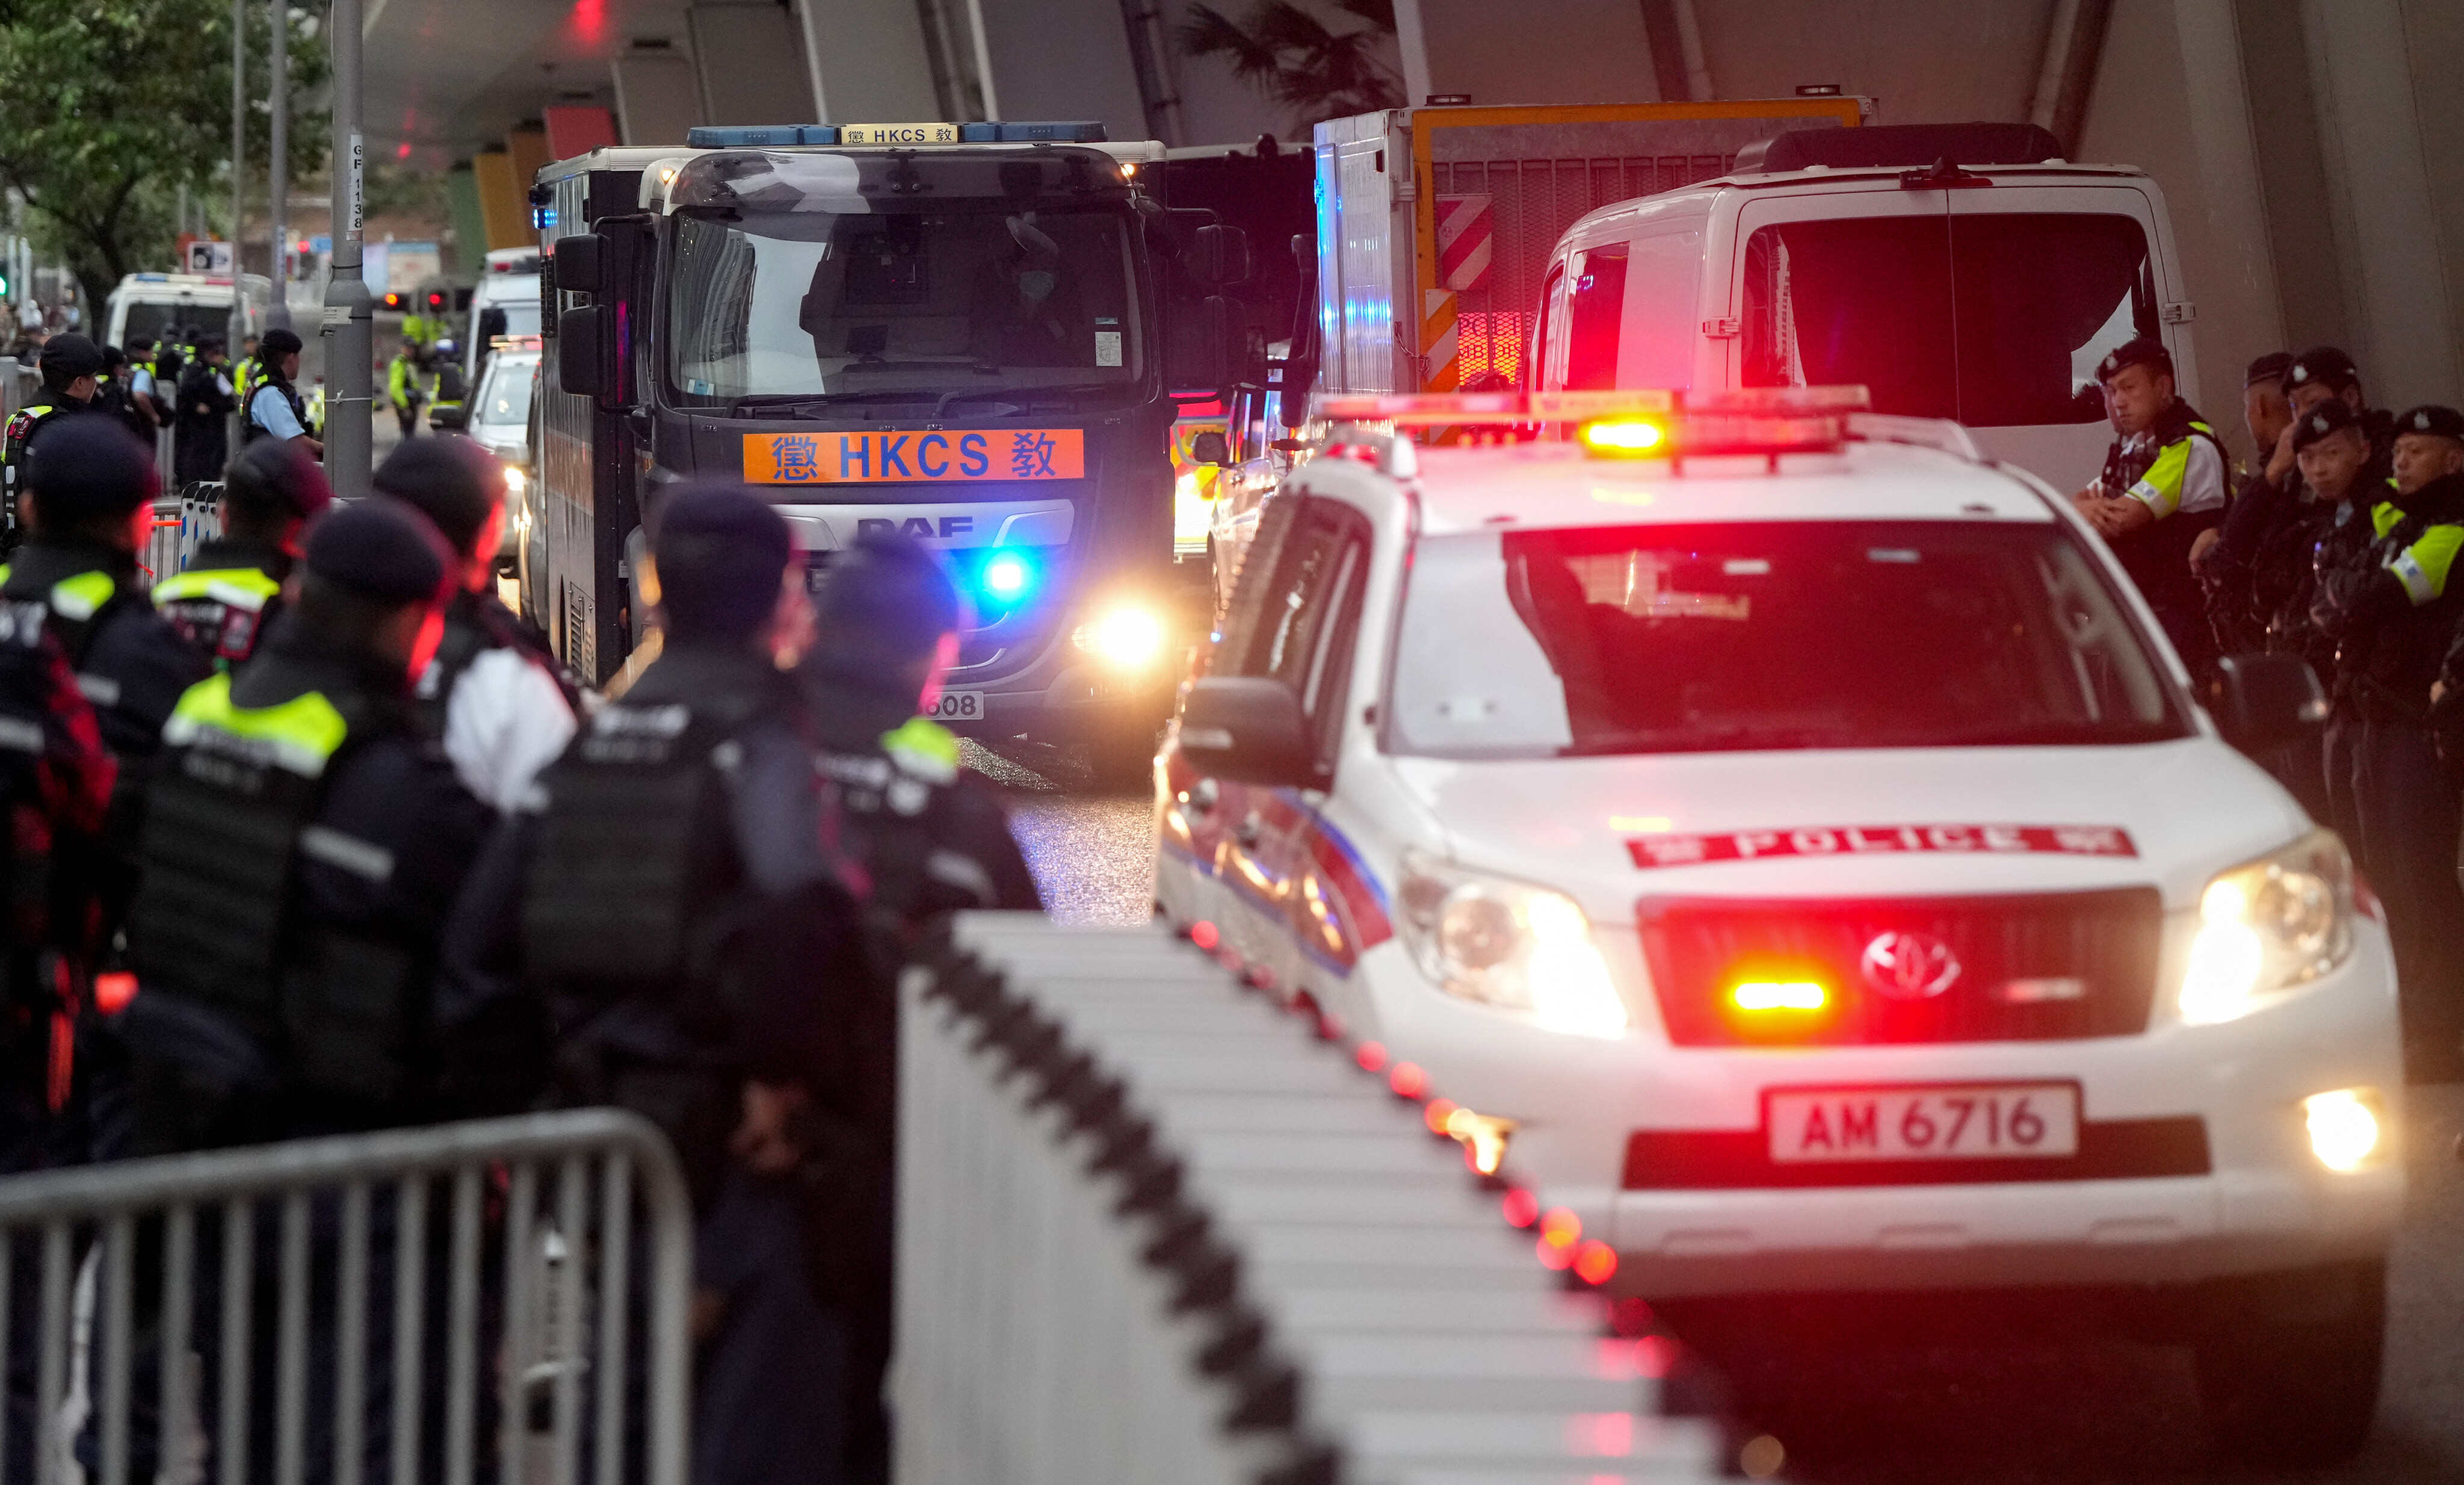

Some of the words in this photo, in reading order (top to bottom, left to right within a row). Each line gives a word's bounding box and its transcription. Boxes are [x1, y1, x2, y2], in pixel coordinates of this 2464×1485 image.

[874, 129, 925, 142] HKCS
[771, 436, 818, 480] 懲
[840, 433, 989, 478] HKCS
[1733, 826, 2028, 857] POLICE
[1800, 1101, 1879, 1149] AM
[1900, 1098, 2046, 1149] 6716
